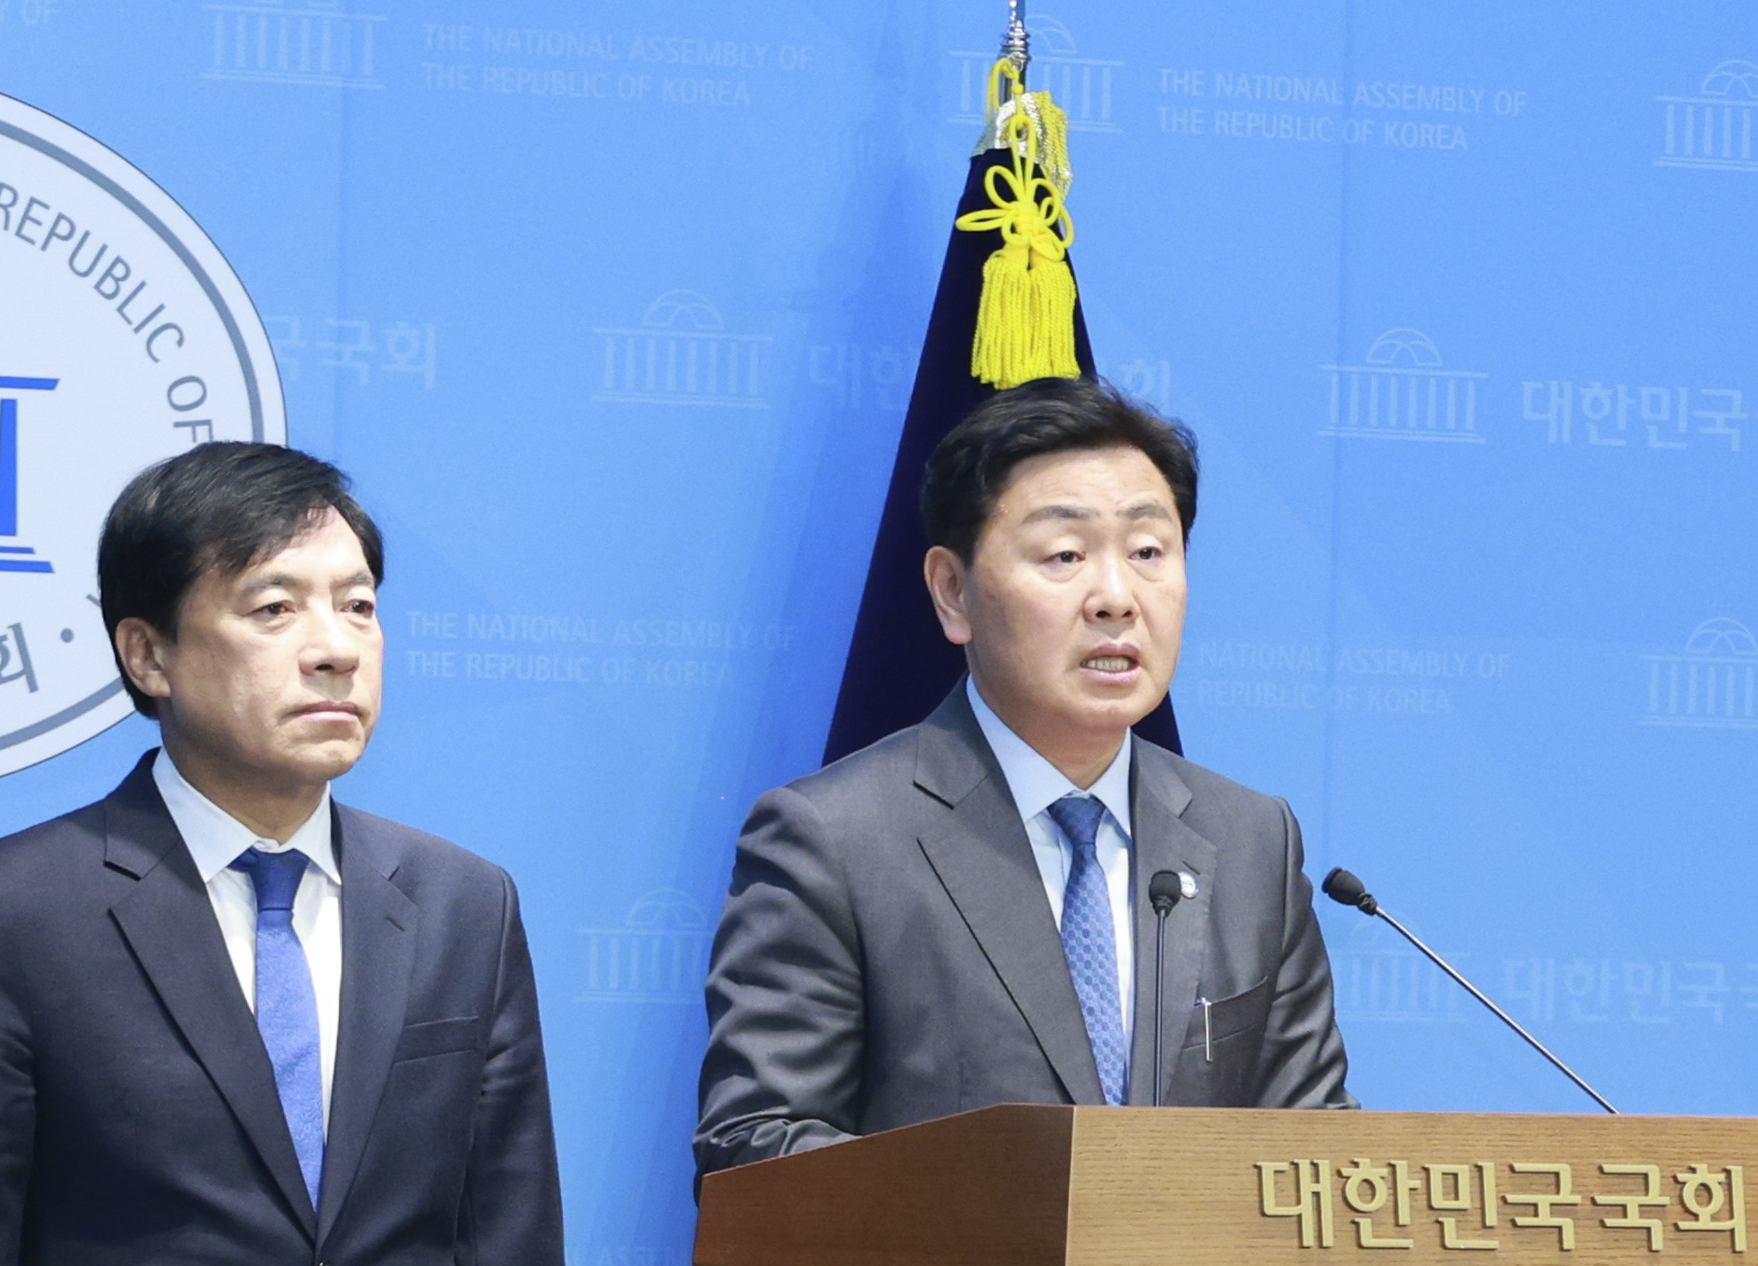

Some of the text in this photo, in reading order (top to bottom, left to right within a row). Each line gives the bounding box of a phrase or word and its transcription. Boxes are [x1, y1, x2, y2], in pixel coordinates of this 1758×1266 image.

[422, 22, 814, 72] THE NATIONAL ASSEMBLY OF
[422, 61, 752, 108] THE REPUBLIC OF KOREA
[1157, 67, 1527, 117] THE NATIONAL ASSEMBLY OF
[1157, 106, 1469, 153] THE REPUBLIC OF KOREA
[406, 610, 457, 640] THE
[466, 612, 603, 647] NATIONAL
[612, 617, 752, 651] ASSEMBLY
[406, 648, 735, 688] THE REPUBLIC OF KOREA
[1197, 641, 1513, 681] NATIONAL ASSEMBLY OF
[1196, 678, 1453, 715] REPUBLIC OF KOREA
[1253, 1158, 1747, 1253] 대한민국국회
